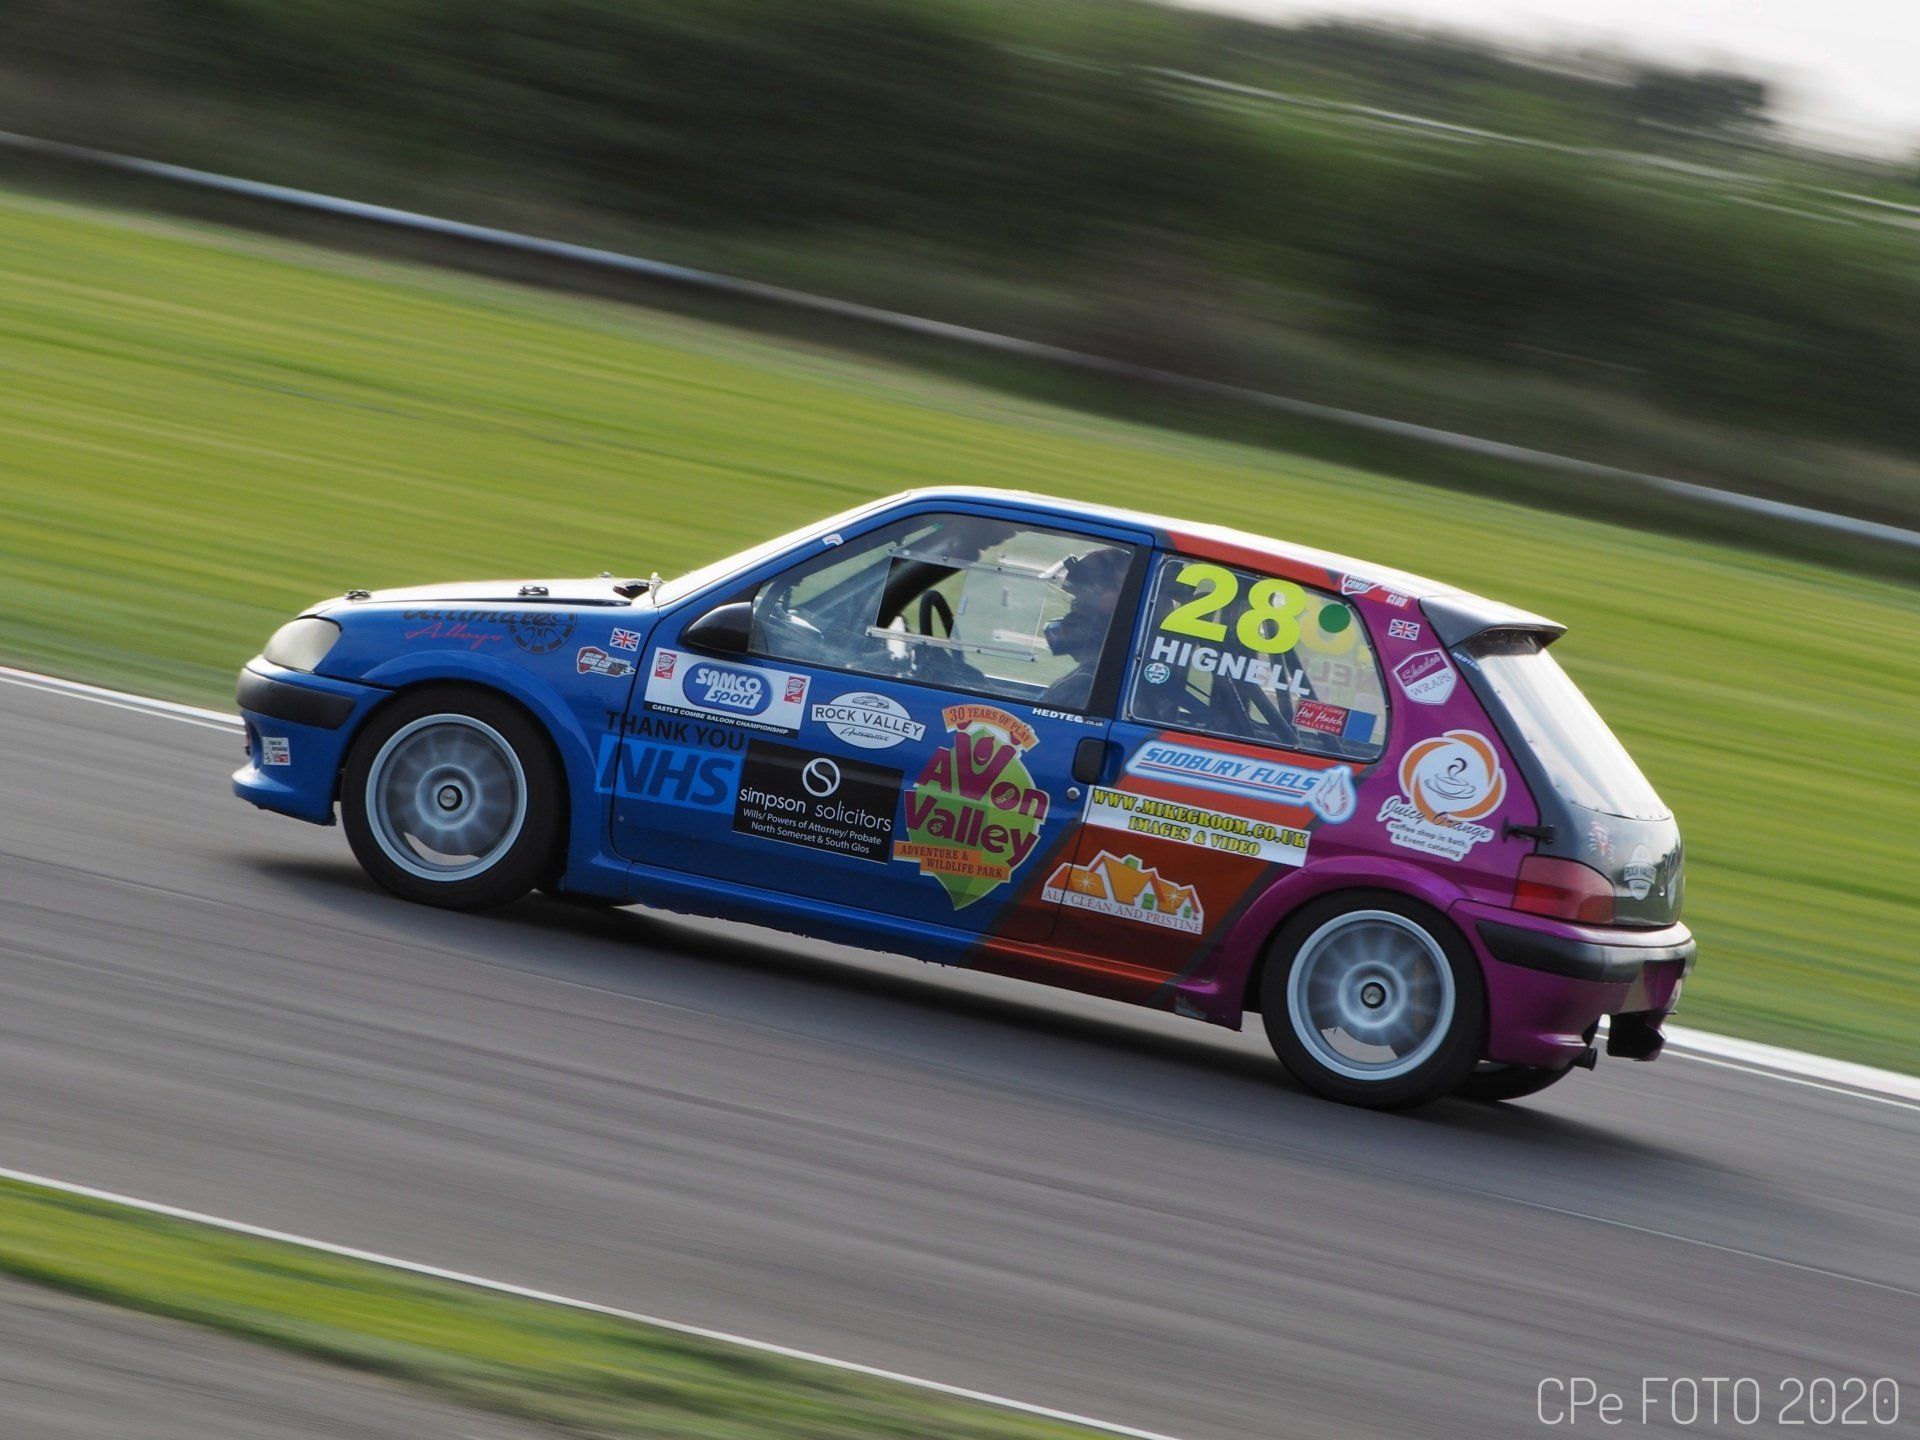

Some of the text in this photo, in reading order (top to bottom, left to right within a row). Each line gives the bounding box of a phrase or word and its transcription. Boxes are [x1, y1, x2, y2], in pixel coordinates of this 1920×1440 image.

[1160, 563, 1307, 654] 28
[696, 668, 761, 694] SAMCO
[1150, 636, 1311, 696] HIGNELL
[710, 689, 754, 705] sport
[950, 708, 965, 723] 30
[967, 708, 997, 721] YEARS
[999, 714, 1010, 726] OF
[606, 710, 744, 751] THANK YOU
[652, 704, 789, 734] CASTLE COMBE SALOON CHAMPIONSHIP
[815, 707, 922, 736] ROCK VALLEY
[599, 741, 736, 806] NHS
[1142, 747, 1320, 791] SODBURY FUELS
[739, 787, 892, 832] simpson solicitors
[743, 808, 882, 845] Wills/ Powers of Attorney/ Probate
[904, 791, 1041, 867] Valley
[1092, 788, 1307, 849] WWW.MIKEGROOM.CO.UK
[1382, 798, 1491, 840] Juicy Orange
[751, 822, 870, 854] North Somerset & South Glos
[901, 844, 969, 861] ADVENTURE &
[1128, 816, 1261, 856] IMAGES & VIDEO
[926, 858, 1003, 878] WILDLIFE PARK
[1043, 888, 1202, 933] ALL CLEAN AND PRISTINE
